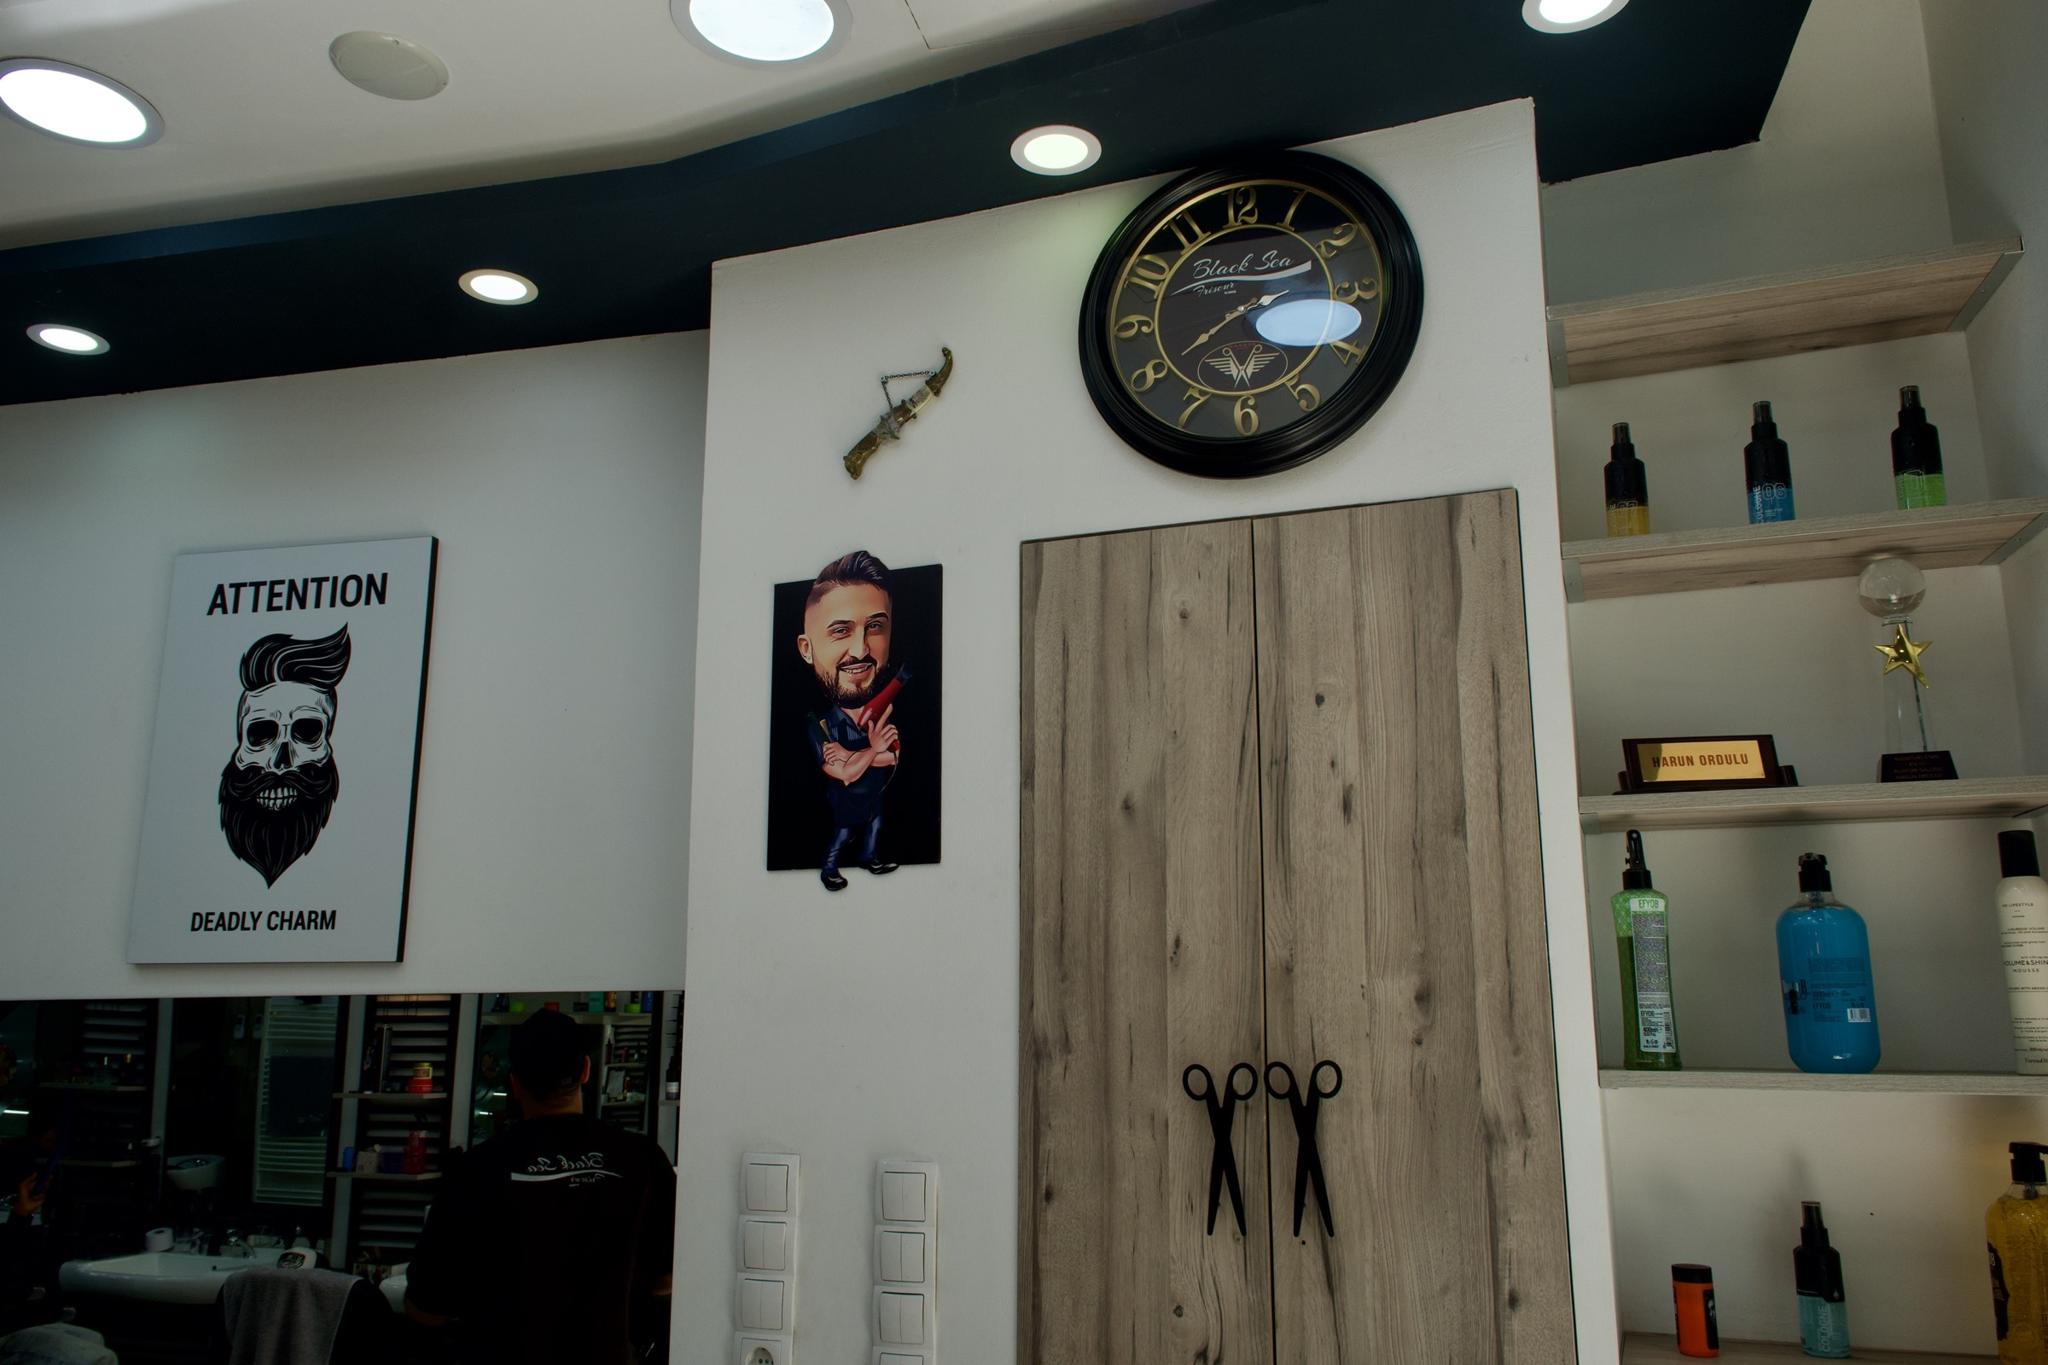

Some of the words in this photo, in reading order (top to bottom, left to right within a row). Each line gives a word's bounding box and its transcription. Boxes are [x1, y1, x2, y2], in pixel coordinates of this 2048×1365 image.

[1222, 186, 1258, 229] 12
[1277, 189, 1309, 232] 1
[1163, 209, 1212, 255] 11
[1315, 222, 1359, 260] 2
[1124, 254, 1170, 300] 10
[1193, 253, 1254, 279] Black
[1254, 250, 1292, 270] Sea
[1334, 277, 1379, 304] 3
[1115, 314, 1155, 339] 9
[1130, 358, 1168, 393] 8
[1177, 386, 1212, 430] 7
[1283, 377, 1321, 413] 5
[1233, 394, 1260, 437] 6
[206, 572, 389, 616] ATTENTION
[1652, 755, 1694, 768] HARUN
[1699, 753, 1749, 766] ORDULU
[190, 911, 262, 931] DEADLY
[267, 910, 336, 930] CHARM
